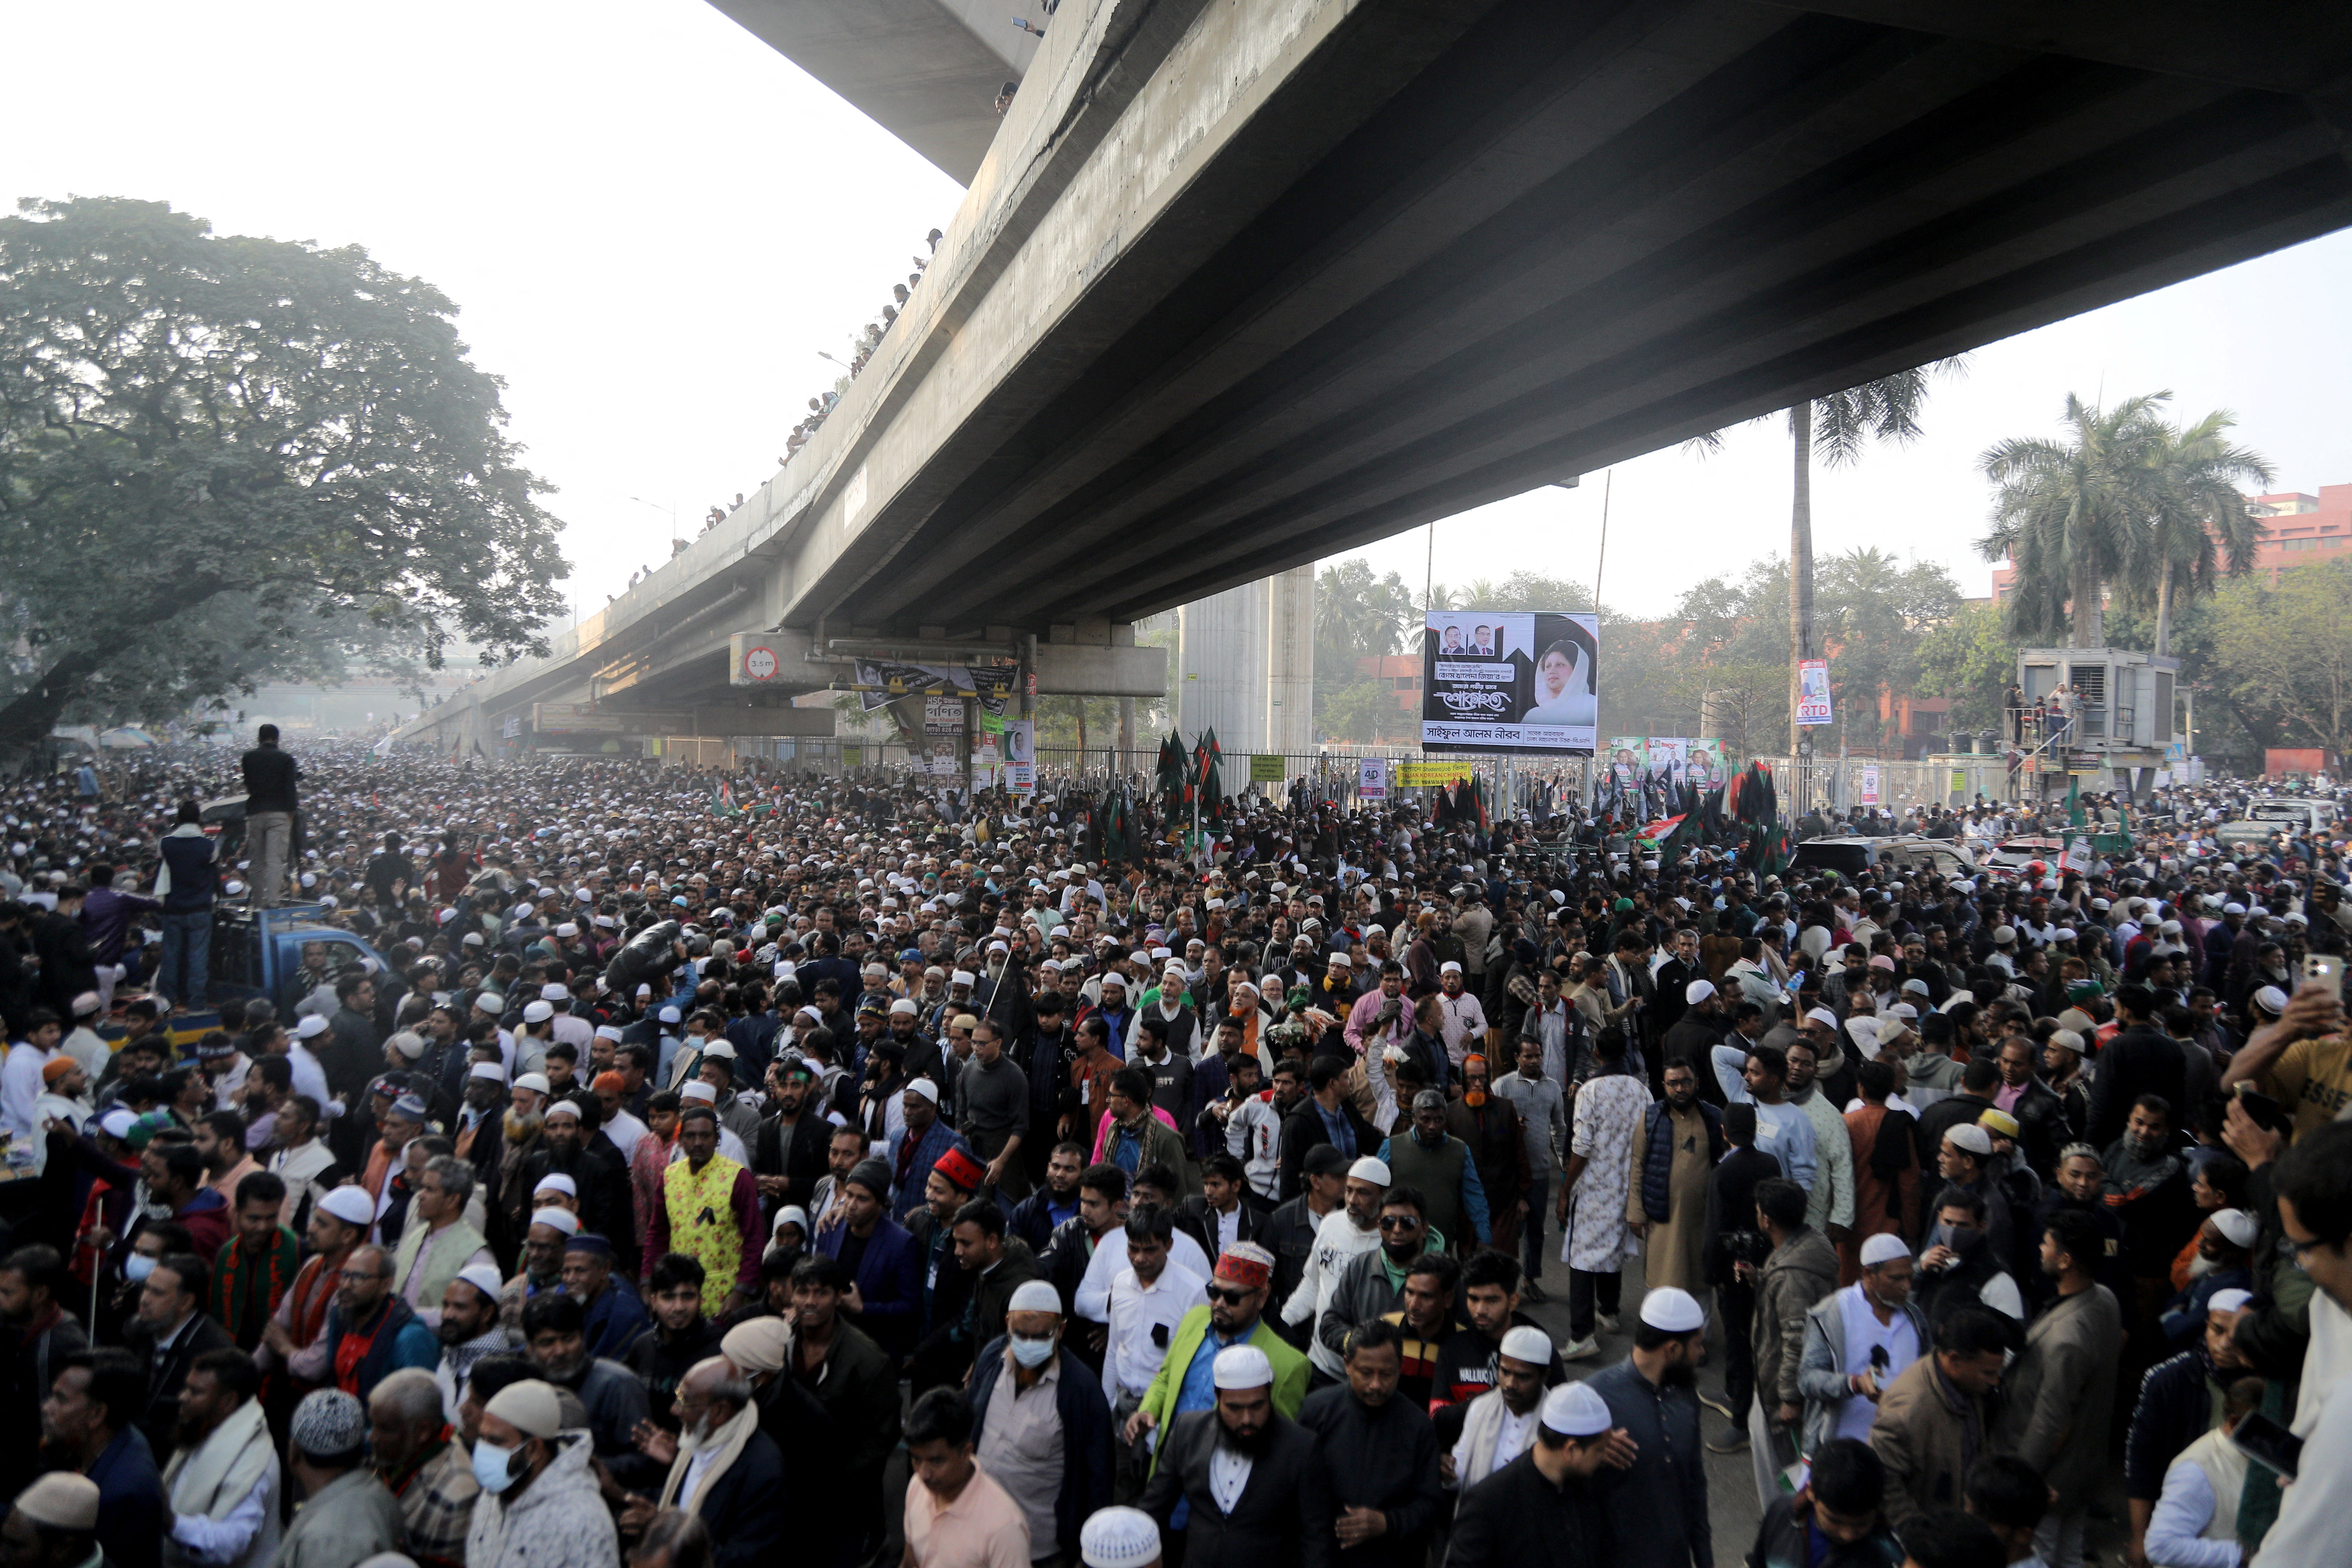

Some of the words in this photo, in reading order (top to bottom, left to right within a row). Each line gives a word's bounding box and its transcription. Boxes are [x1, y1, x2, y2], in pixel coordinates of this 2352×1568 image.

[1433, 691, 1512, 712] শোকাহত
[927, 705, 963, 716] গণিত
[1801, 705, 1828, 716] RTD
[1427, 726, 1460, 740] সাইফুল
[1463, 730, 1492, 738] আলম
[1495, 727, 1520, 739] নীরব
